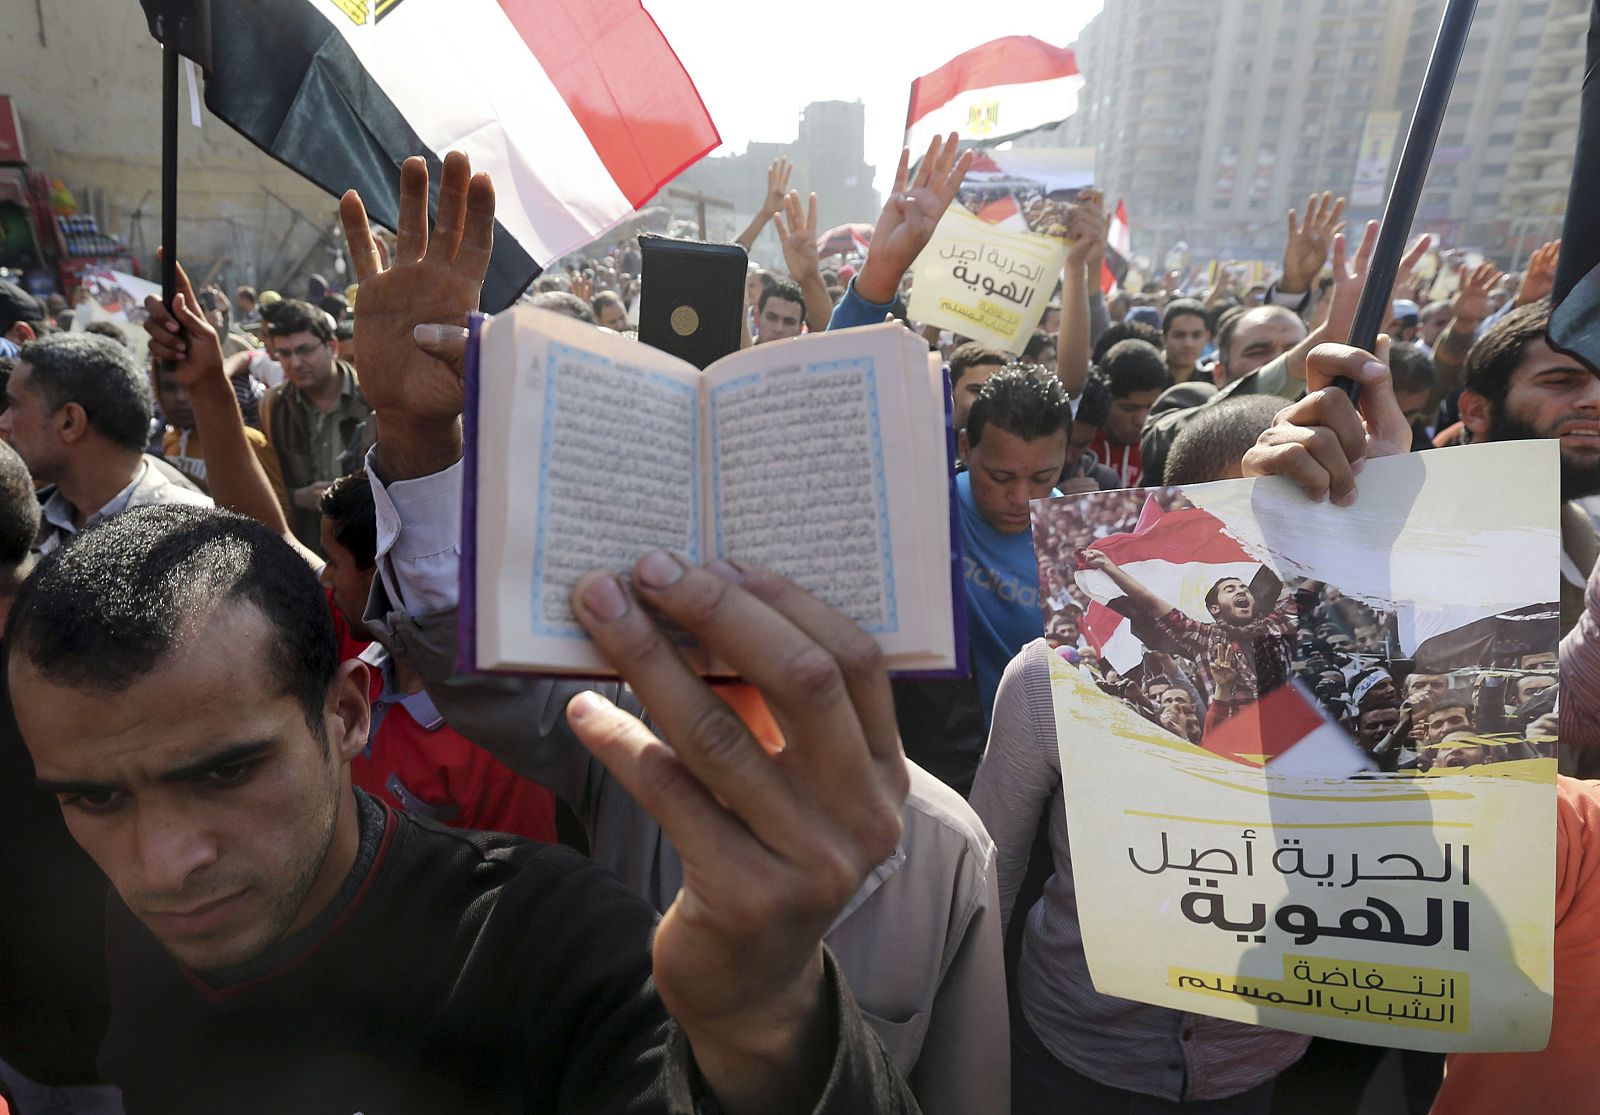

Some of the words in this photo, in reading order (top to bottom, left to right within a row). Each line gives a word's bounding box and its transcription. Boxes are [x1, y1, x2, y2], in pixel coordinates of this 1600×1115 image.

[952, 259, 1035, 308] الهوية
[962, 556, 1041, 609] adida
[1128, 829, 1257, 876] أصل
[1272, 838, 1470, 888] الحرية
[1180, 877, 1470, 952] الهوية
[1178, 975, 1322, 1008] المسلم
[1293, 960, 1455, 999] انتفاضة
[1330, 994, 1455, 1024] الشباب
